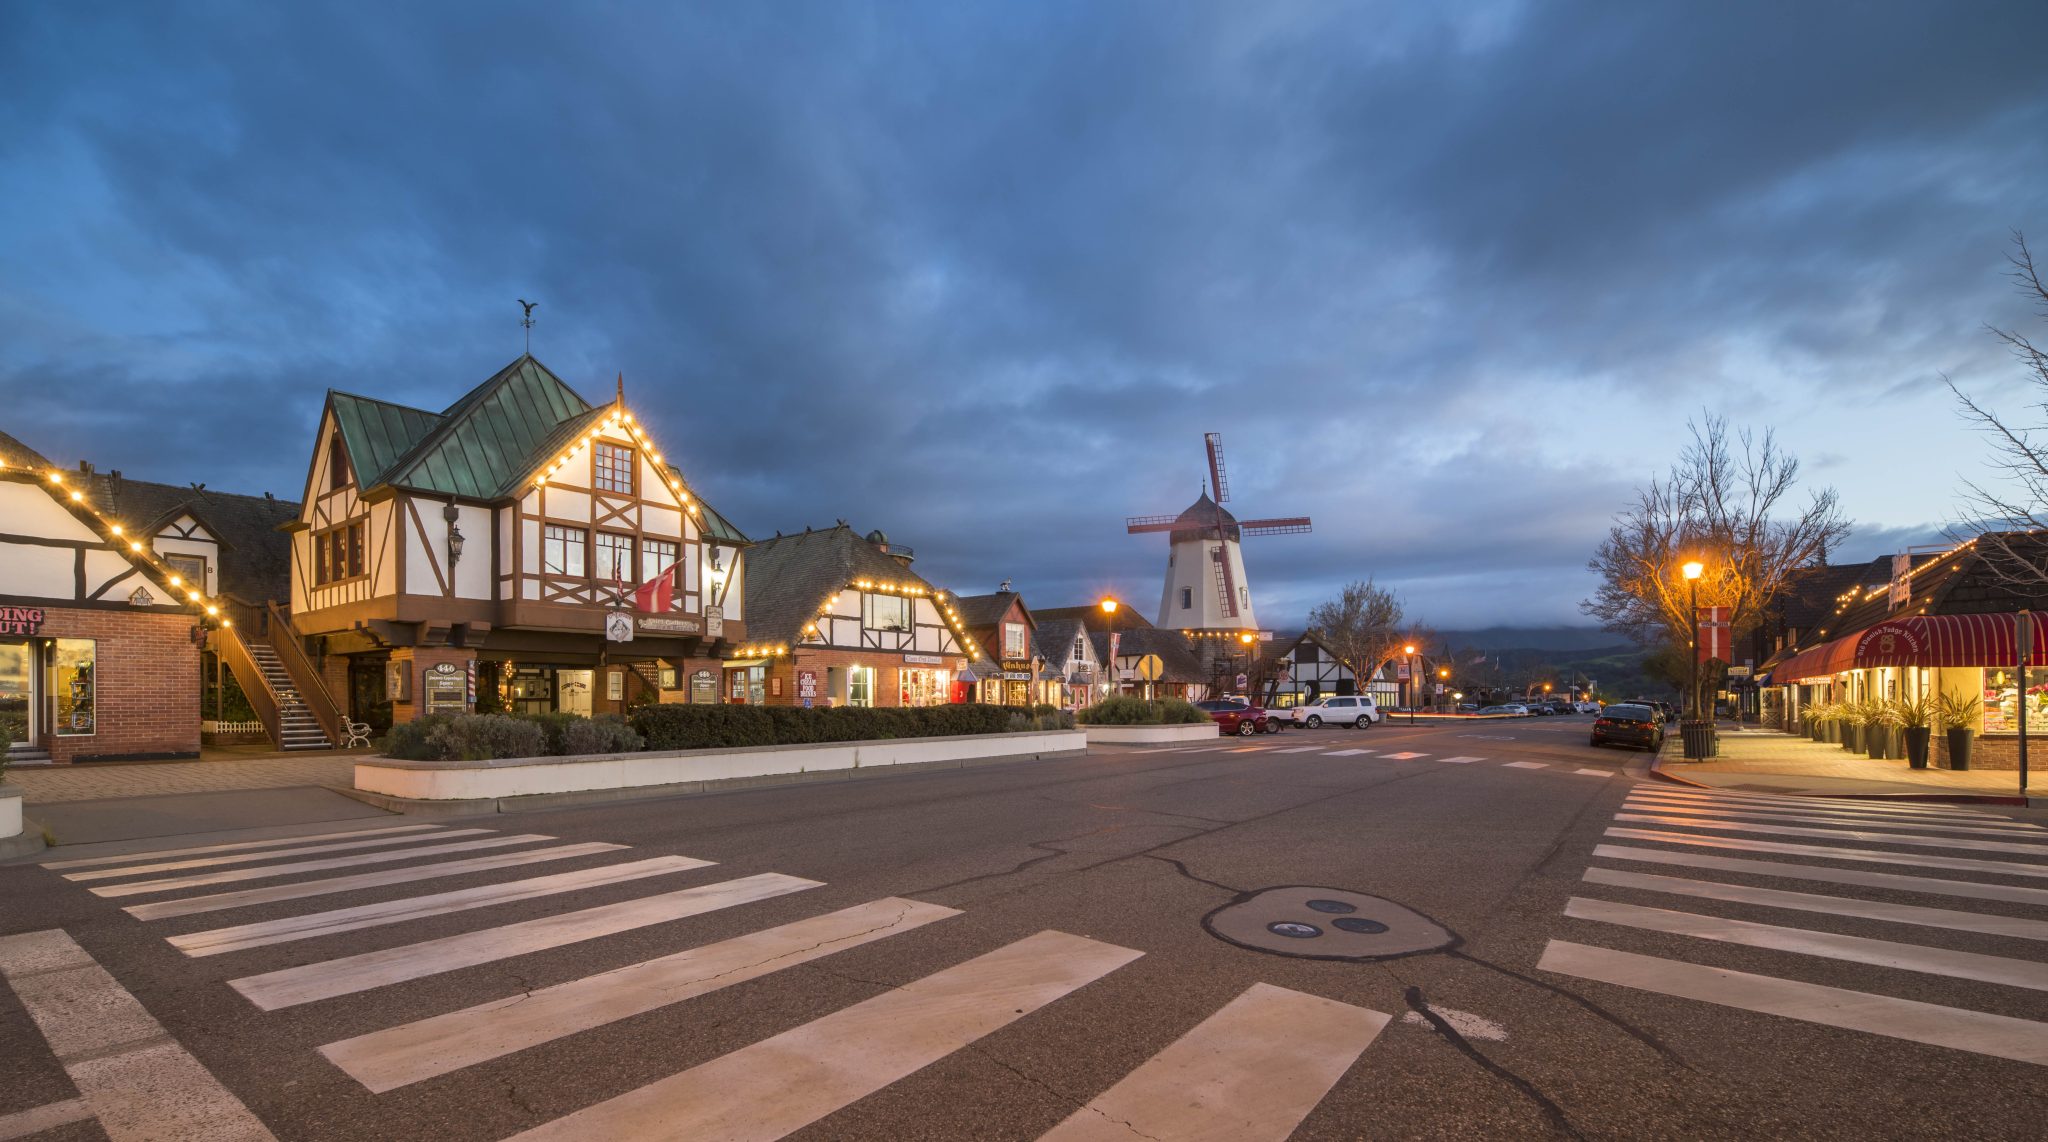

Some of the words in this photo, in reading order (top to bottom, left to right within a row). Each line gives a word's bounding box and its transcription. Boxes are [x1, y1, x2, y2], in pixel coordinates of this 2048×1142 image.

[0, 608, 42, 621] ING
[1862, 628, 1883, 646] Danish
[1882, 626, 1903, 635] Fudge
[1902, 630, 1919, 653] Kitchen
[437, 664, 455, 673] 446
